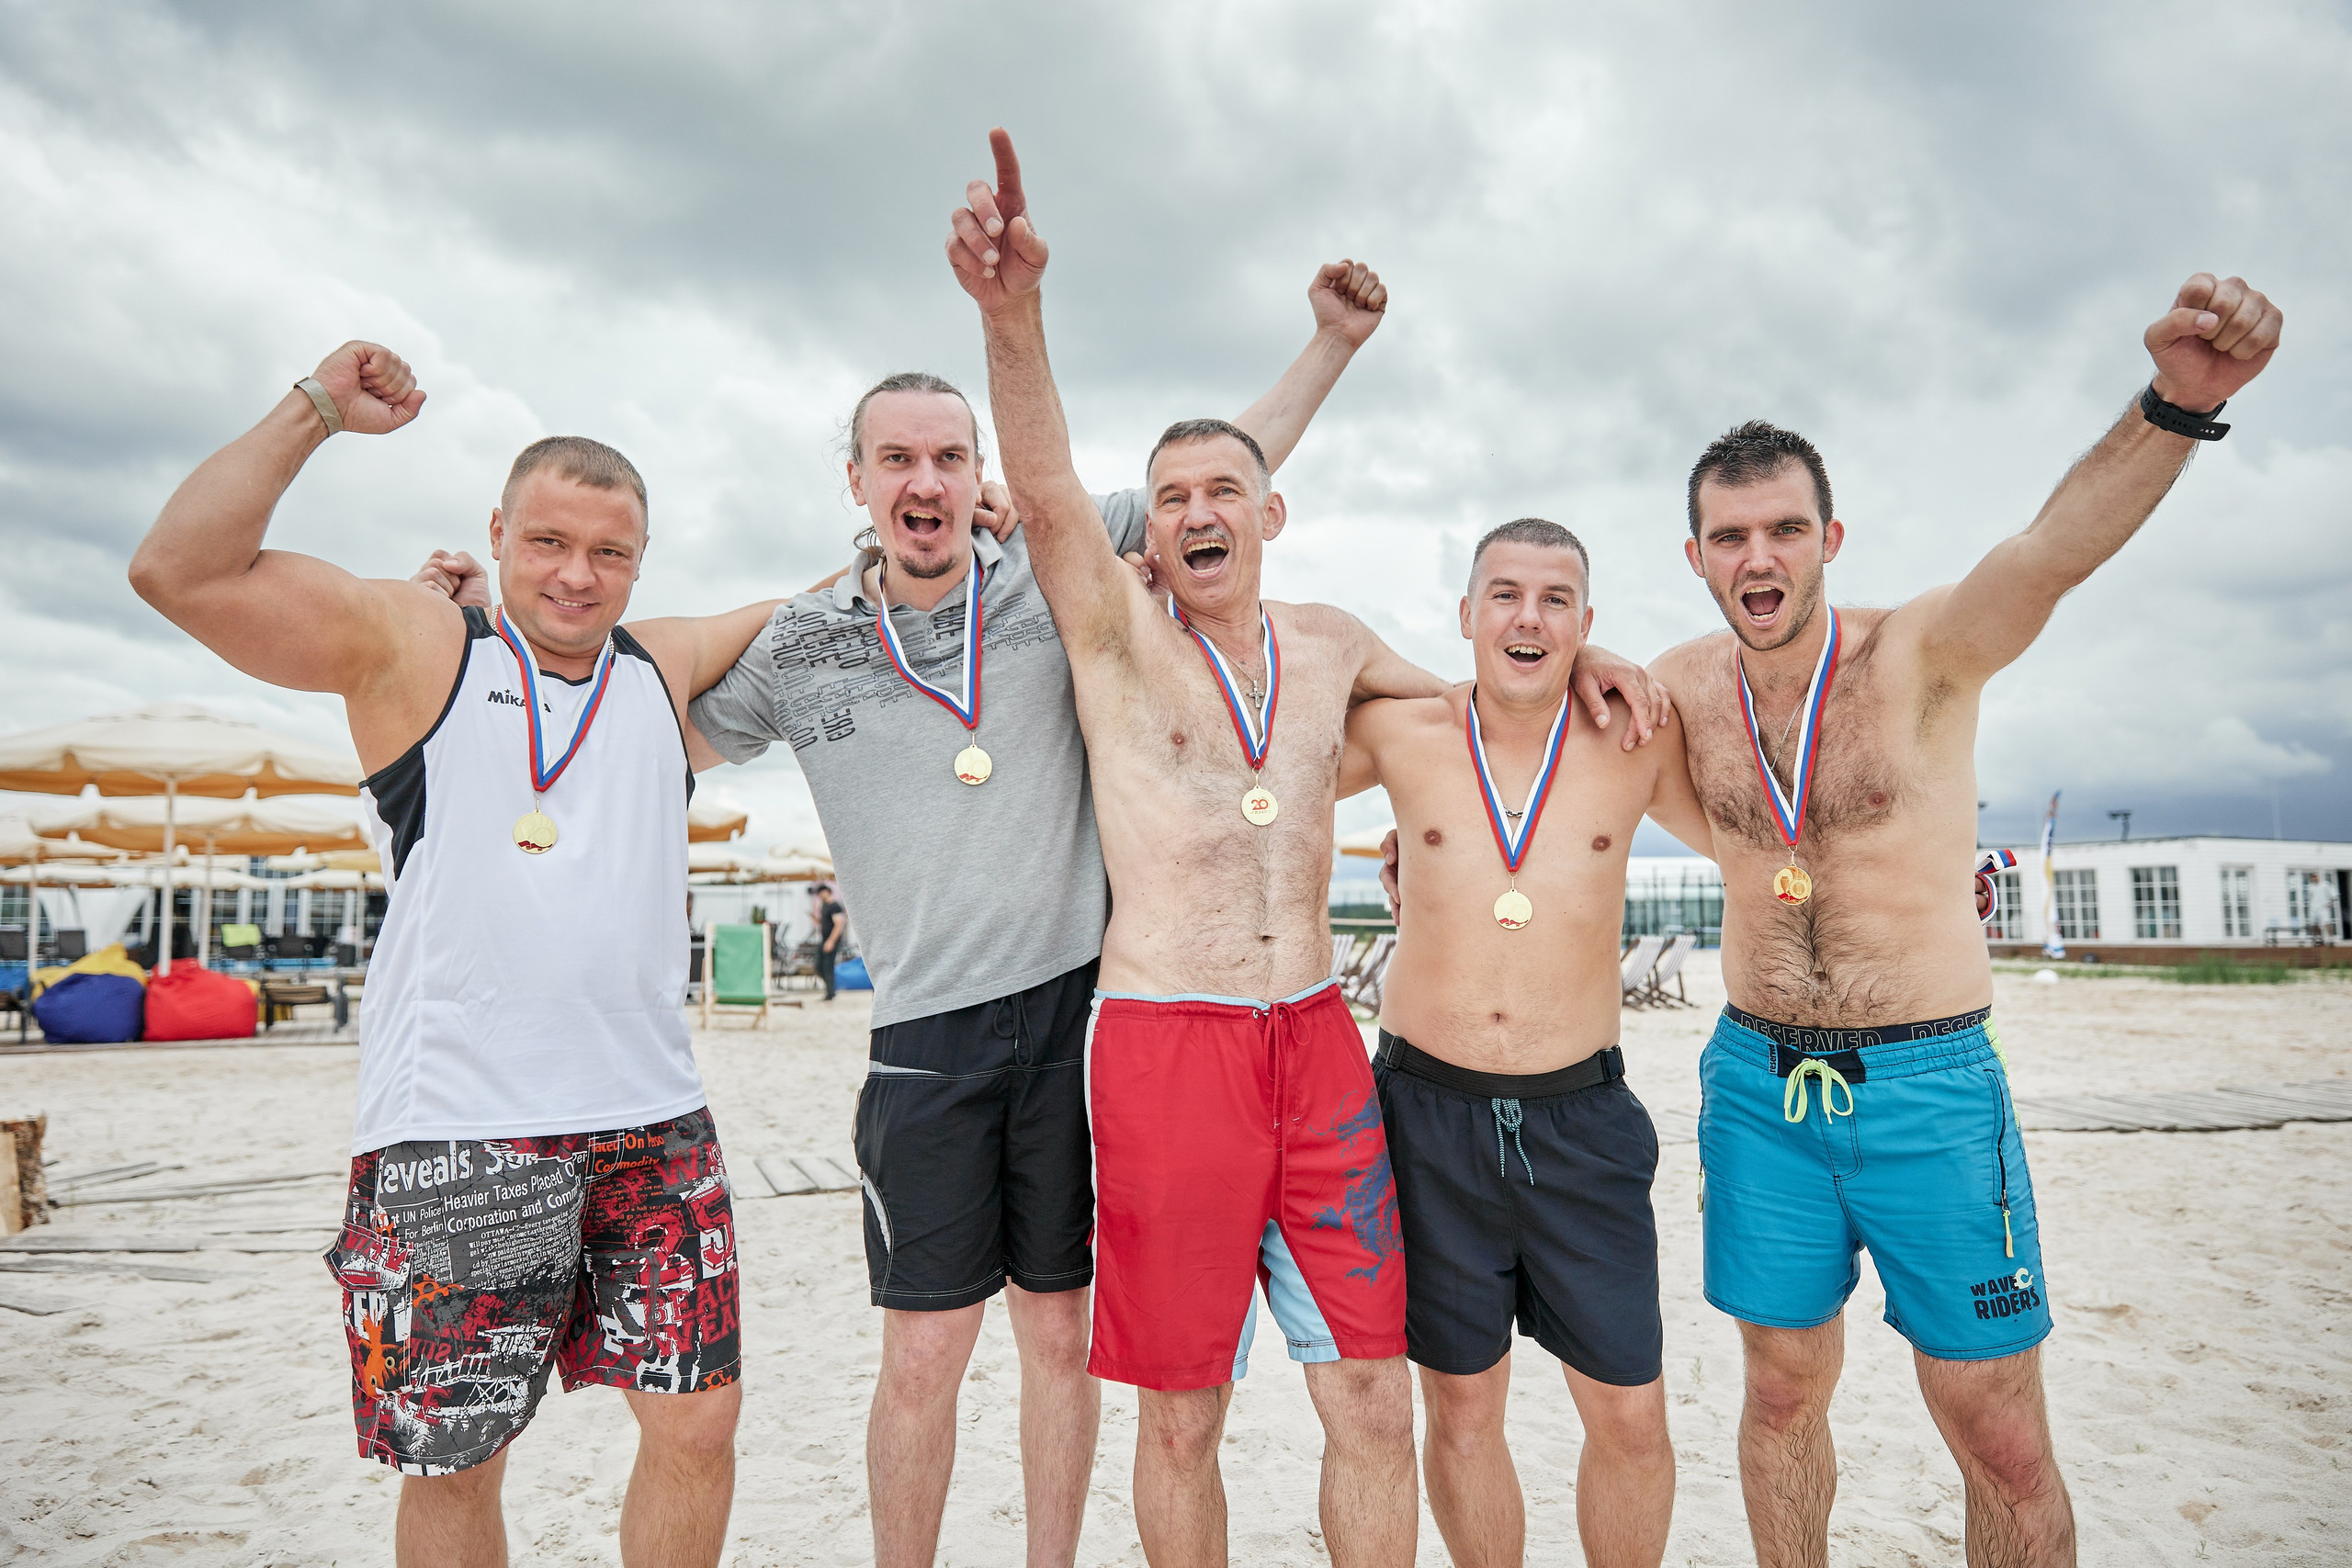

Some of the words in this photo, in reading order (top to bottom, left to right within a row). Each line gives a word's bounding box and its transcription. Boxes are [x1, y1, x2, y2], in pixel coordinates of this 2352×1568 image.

[1250, 798, 1269, 810] 20
[625, 1133, 645, 1150] On
[444, 1190, 489, 1212] Heavier
[492, 1181, 528, 1201] Taxes
[530, 1167, 564, 1192] Placed
[402, 1210, 416, 1224] UN
[447, 1208, 517, 1234] Corporation
[522, 1200, 543, 1218] and
[404, 1228, 420, 1240] For
[421, 1220, 445, 1237] Berlin
[1970, 1275, 2019, 1297] WAVE
[1973, 1286, 2041, 1320] RIDERS
